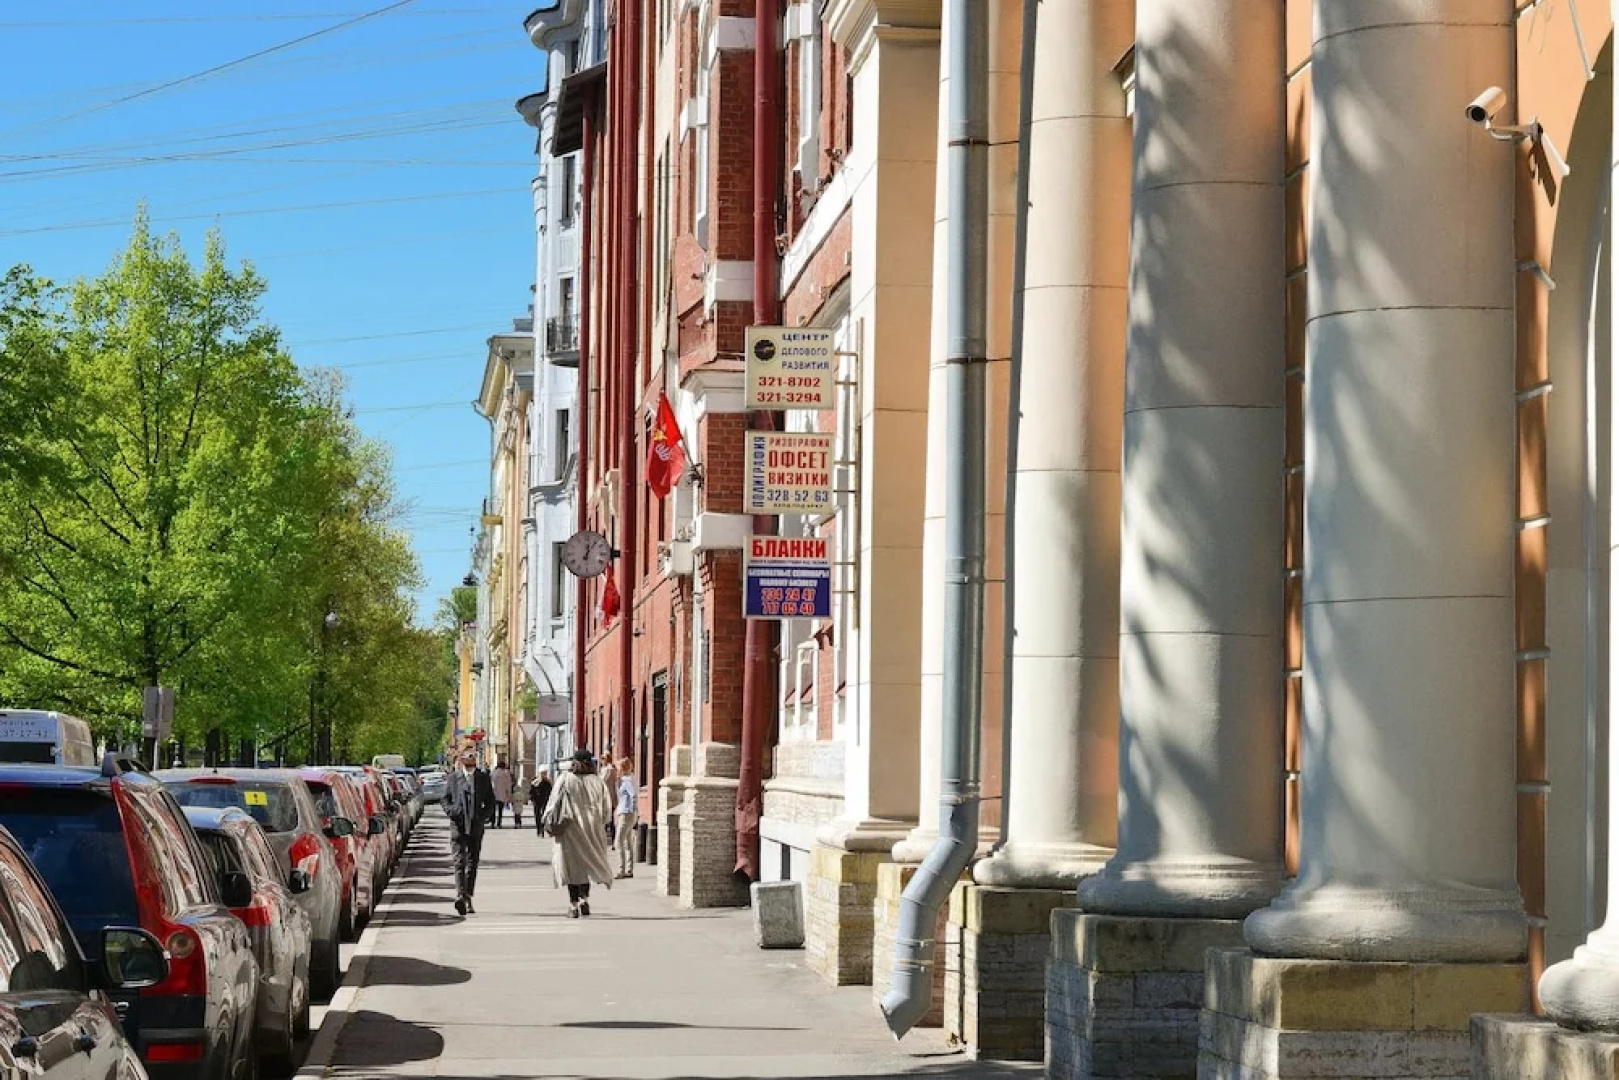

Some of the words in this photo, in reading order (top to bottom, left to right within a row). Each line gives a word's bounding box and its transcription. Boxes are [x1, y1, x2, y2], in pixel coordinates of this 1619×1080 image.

[782, 333, 829, 342] ЦЕНТР
[781, 347, 828, 356] ДЕЛОВОГО
[781, 361, 829, 370] РАЗВИТИЯ
[758, 376, 821, 387] 321-8702
[757, 392, 821, 402] 321-3294
[768, 450, 828, 468] ОФСЕТ
[752, 436, 765, 507] ПОЛИГРАФИЯ
[768, 472, 828, 485] ВИЗИТКИ
[752, 539, 826, 558] БЛАНКИ
